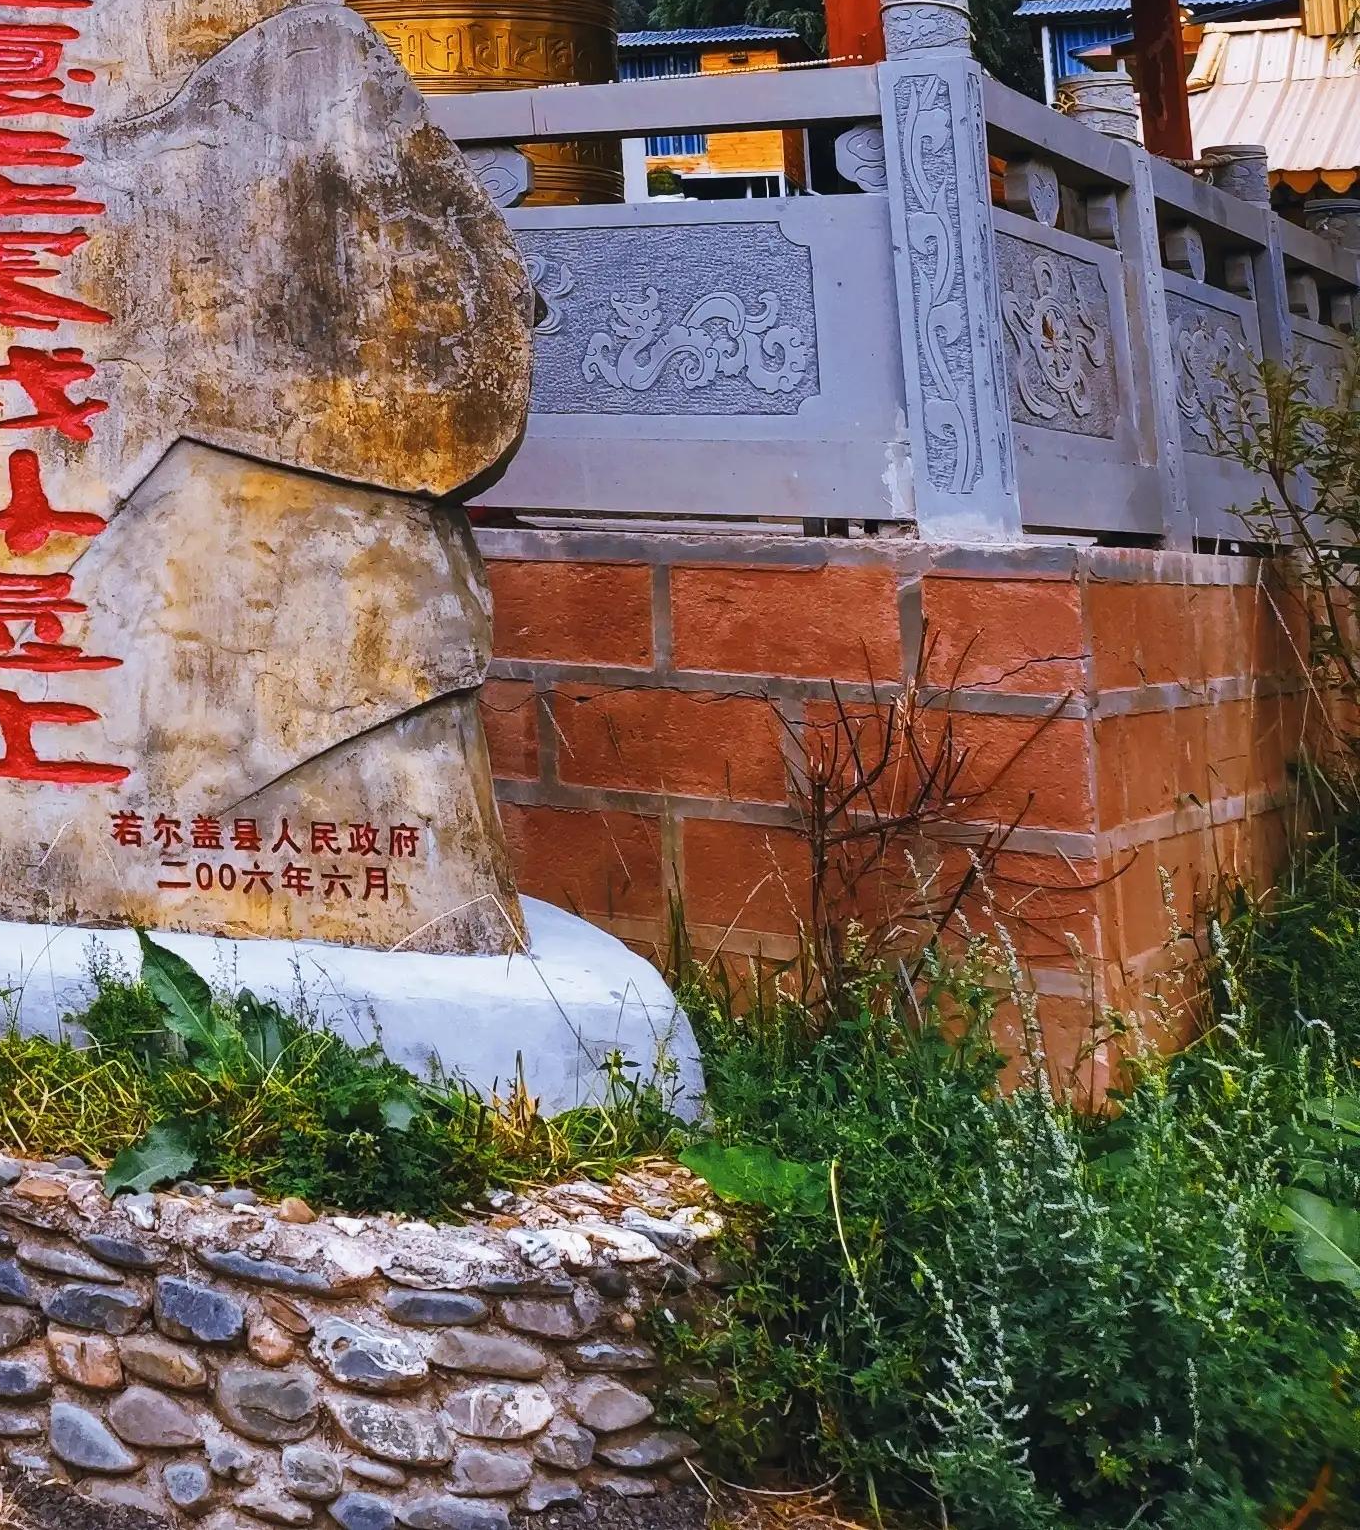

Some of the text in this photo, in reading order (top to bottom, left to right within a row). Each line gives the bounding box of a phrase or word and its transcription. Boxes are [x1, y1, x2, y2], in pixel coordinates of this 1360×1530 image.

[111, 810, 420, 858] 若尔盖县人民政府
